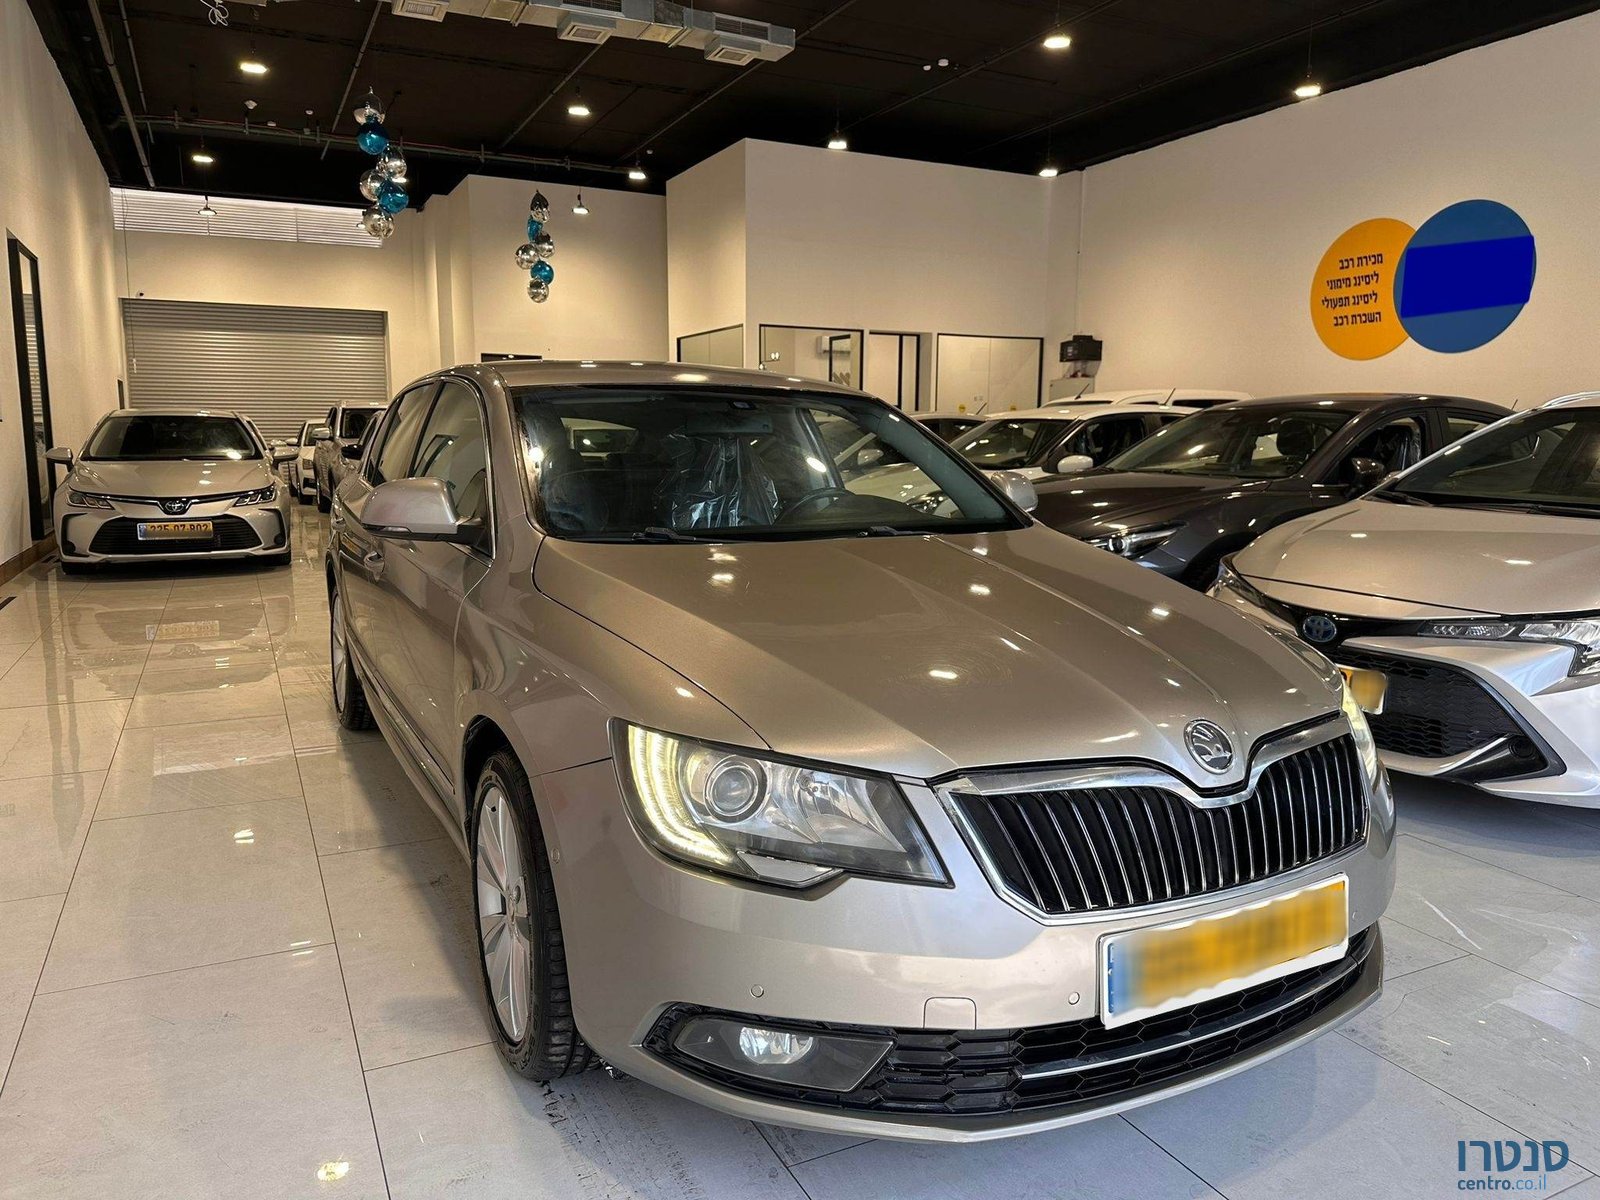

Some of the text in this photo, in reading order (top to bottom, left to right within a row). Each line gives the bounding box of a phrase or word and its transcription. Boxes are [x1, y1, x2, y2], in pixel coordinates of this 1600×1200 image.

[1339, 253, 1383, 270] מכירת רכב
[1326, 271, 1379, 290] ליסינג מימוני
[1322, 290, 1378, 310] ליסינג תפעולי
[1333, 311, 1382, 327] השכרת רכב
